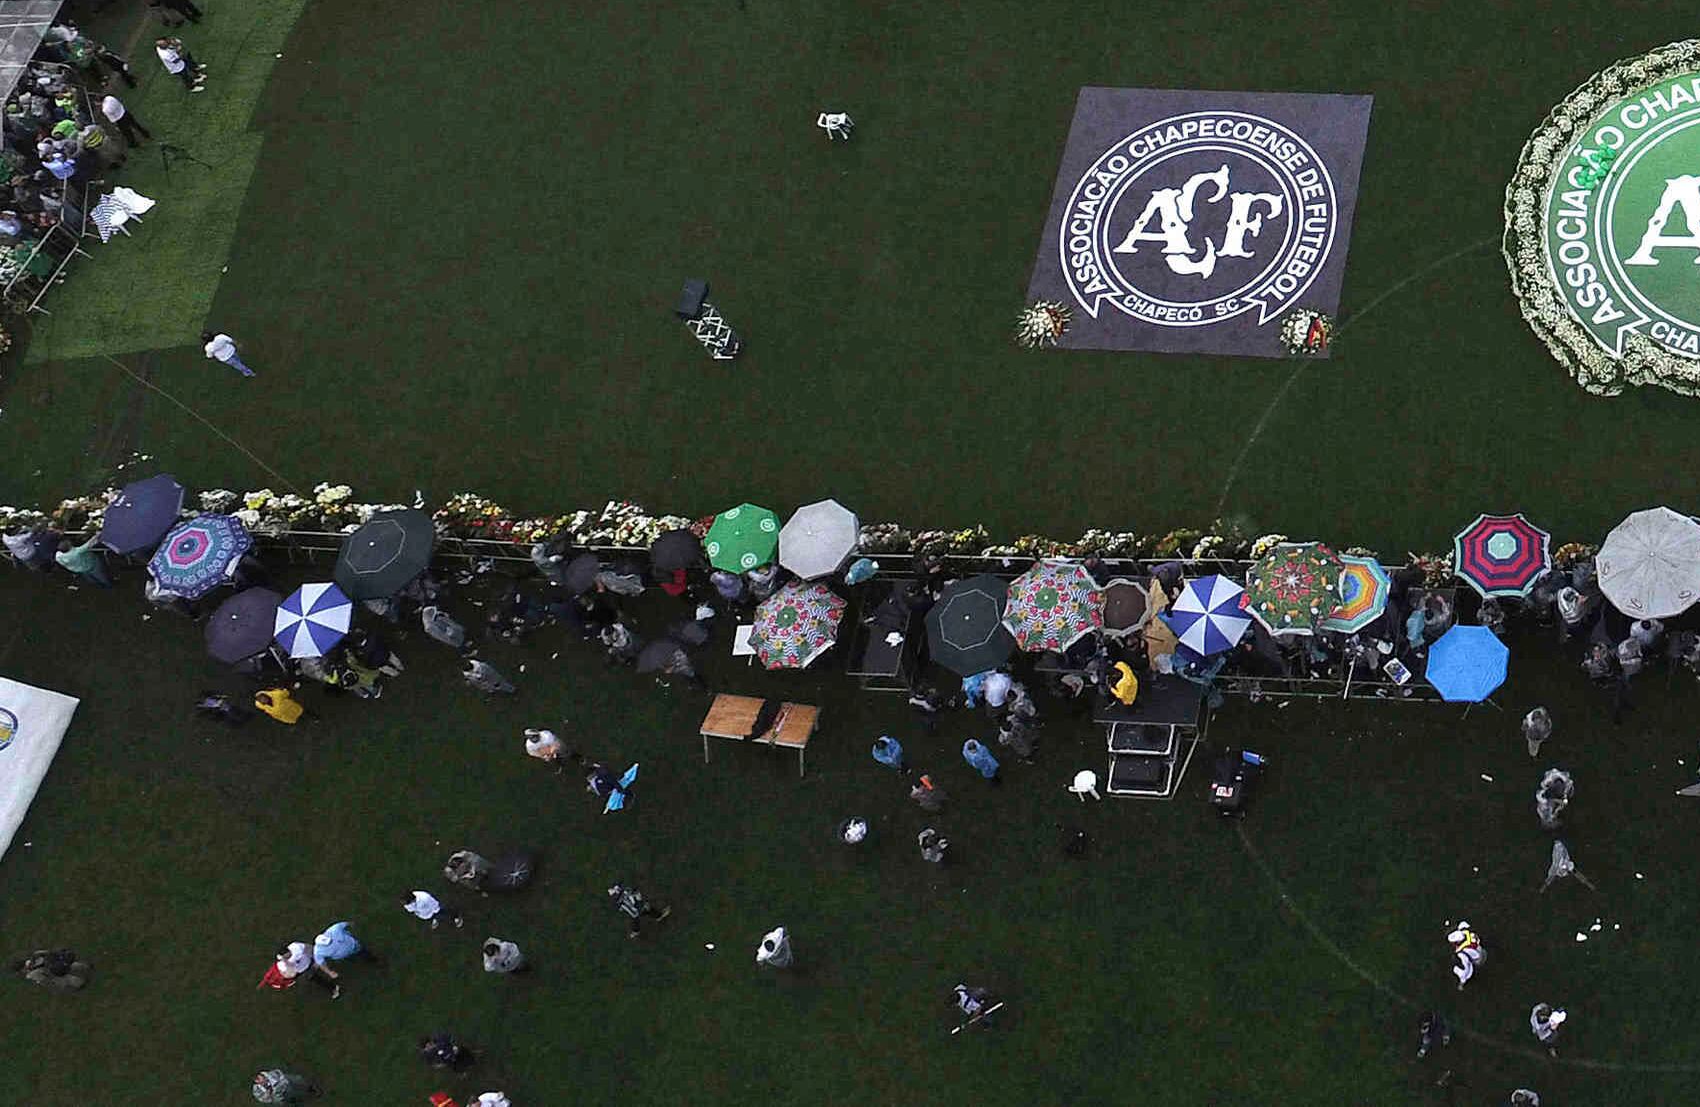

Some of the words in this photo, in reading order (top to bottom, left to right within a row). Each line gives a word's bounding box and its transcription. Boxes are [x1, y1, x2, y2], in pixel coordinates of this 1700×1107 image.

[1128, 118, 1308, 172] CHAPECOENSE
[1113, 164, 1285, 279] ACF
[1296, 167, 1326, 202] DE
[1069, 156, 1130, 295] ASSOCIAÇÃO
[1260, 202, 1328, 302] FUTEBOL
[1122, 292, 1203, 322] CHAPECÓ
[1215, 297, 1241, 316] SC
